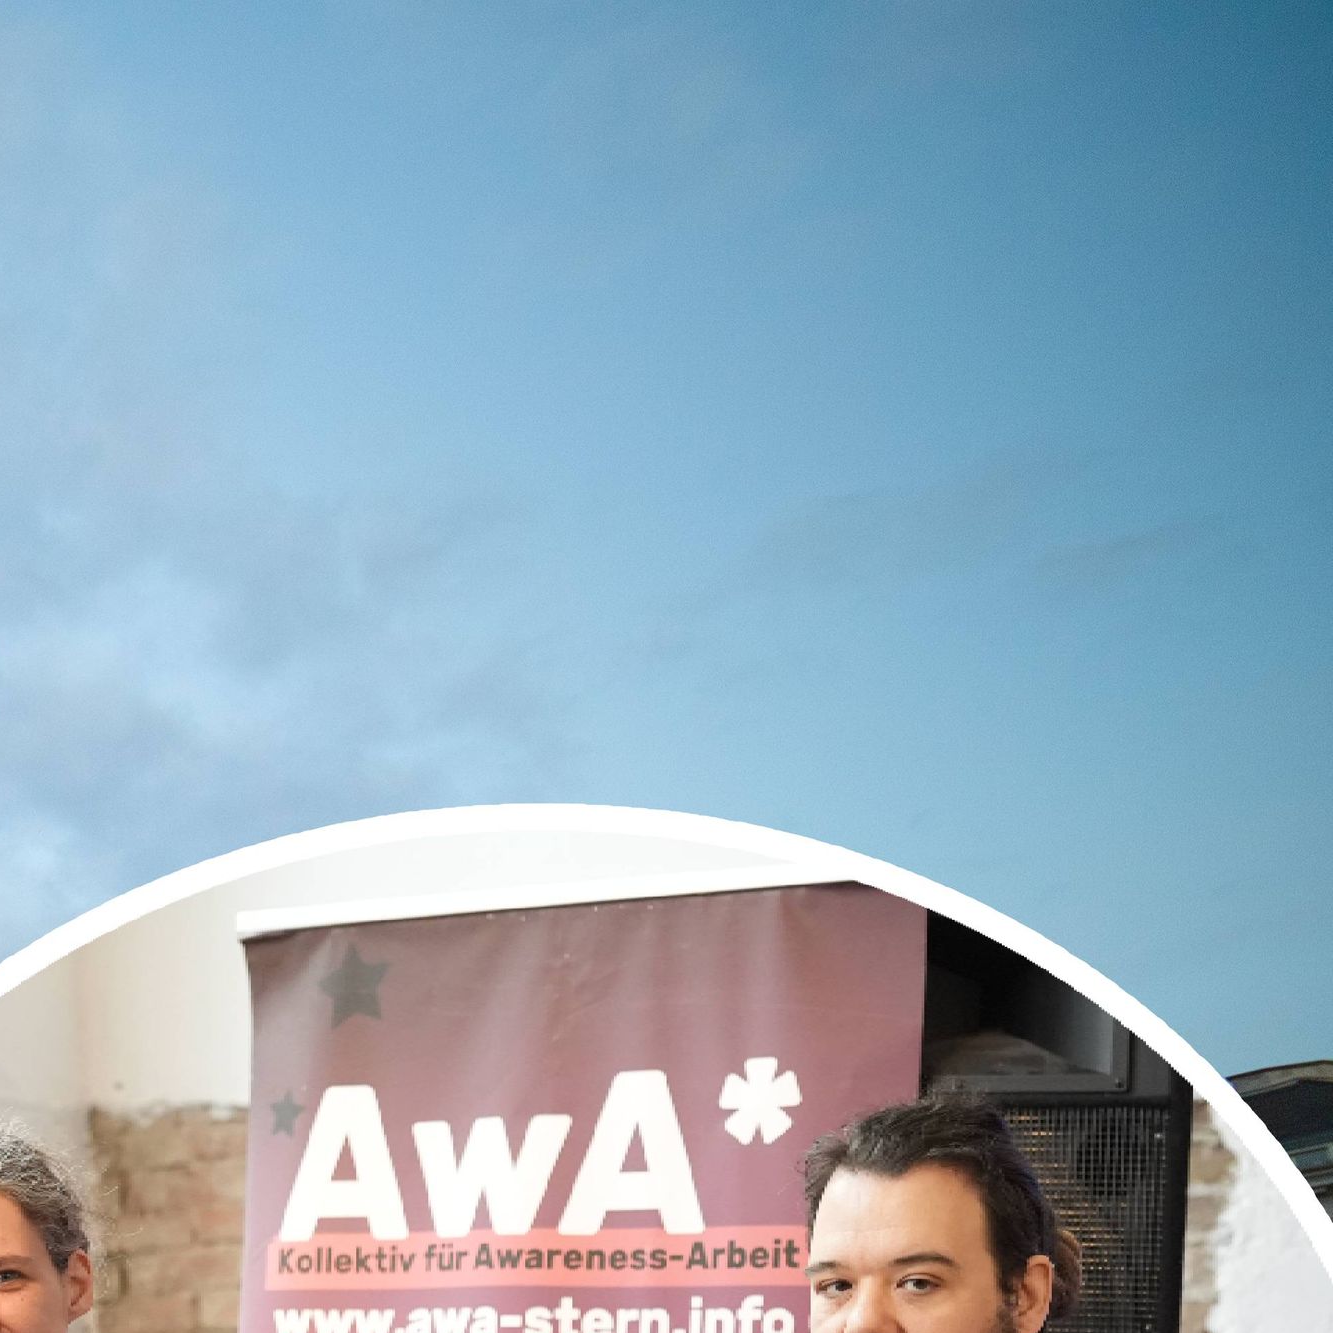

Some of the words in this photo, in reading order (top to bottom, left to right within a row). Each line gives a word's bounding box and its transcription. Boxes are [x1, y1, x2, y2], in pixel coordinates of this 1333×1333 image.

[278, 1247, 416, 1275] Kollektiv
[424, 1244, 467, 1272] für
[473, 1238, 800, 1271] Awareness-Arbeit
